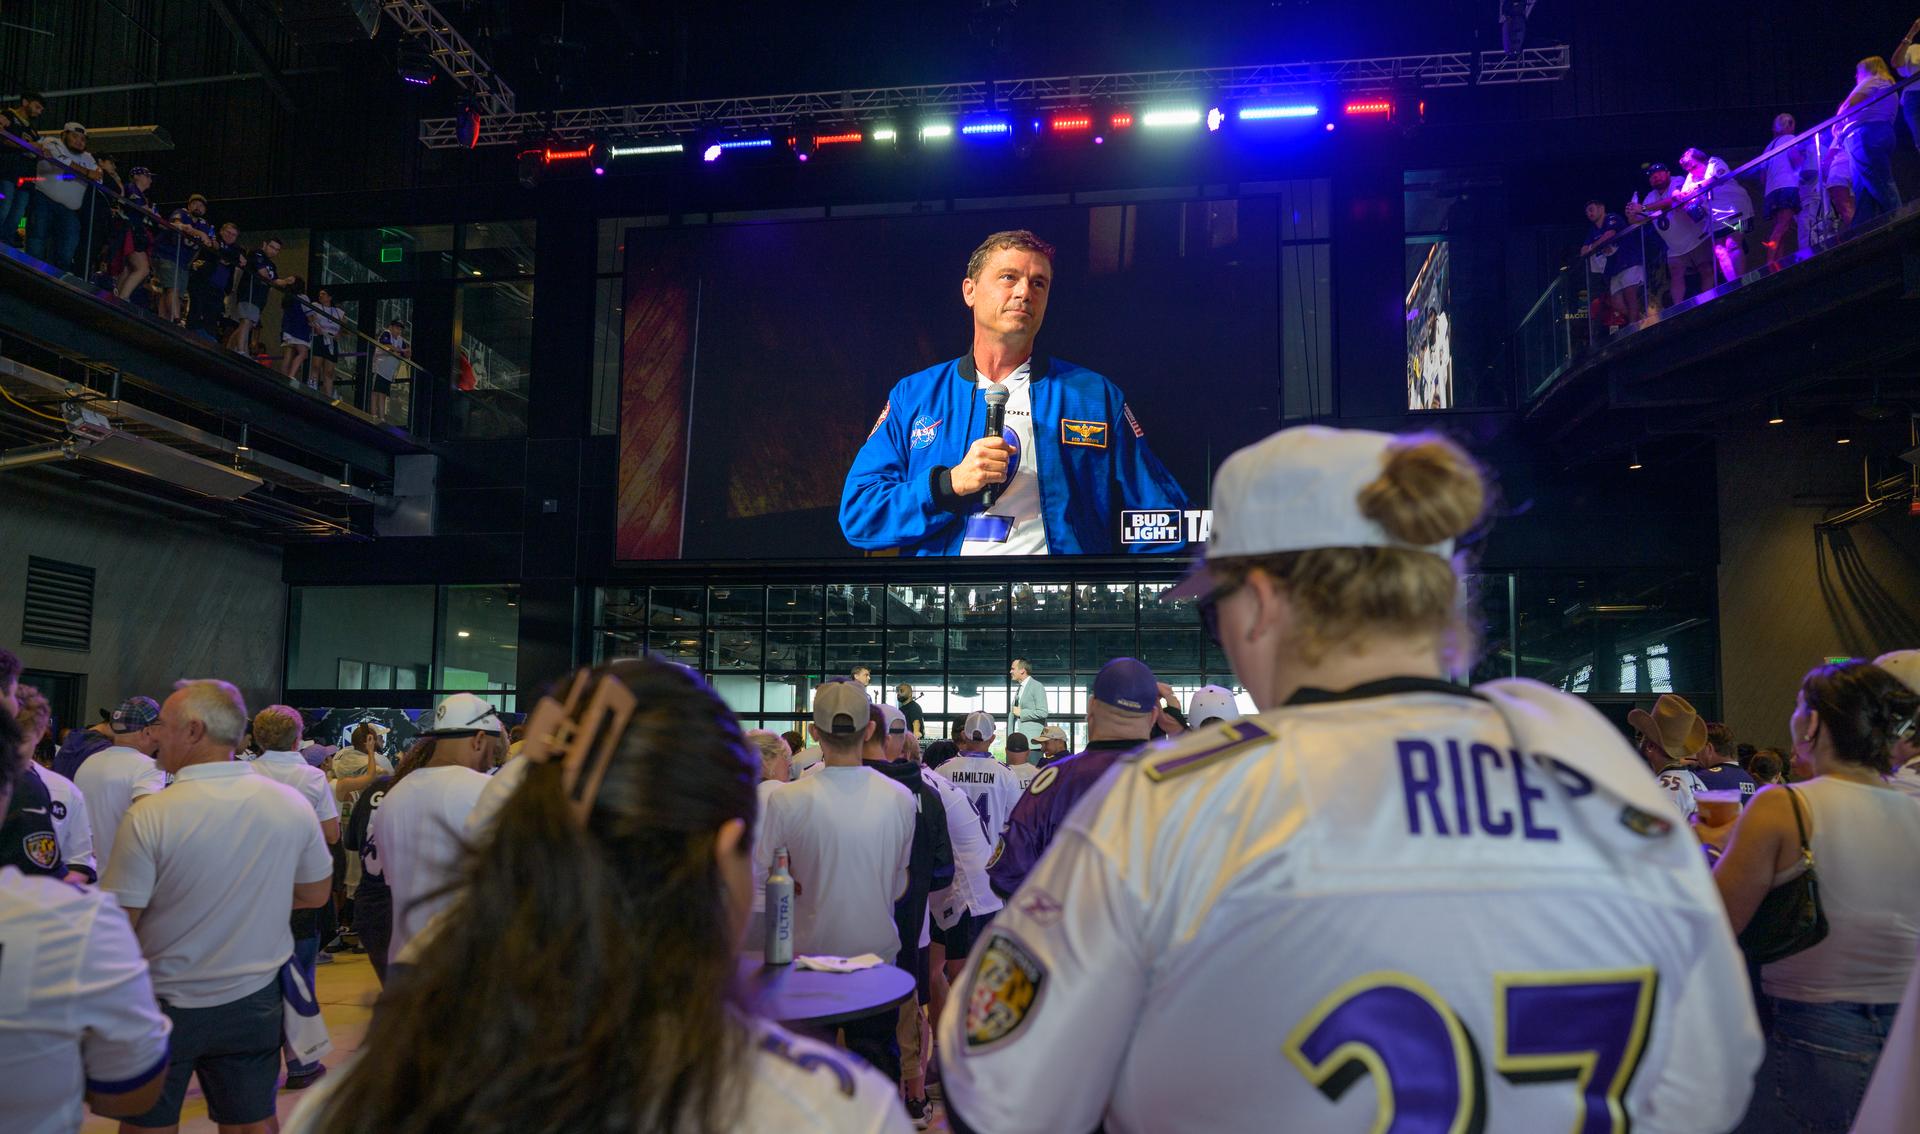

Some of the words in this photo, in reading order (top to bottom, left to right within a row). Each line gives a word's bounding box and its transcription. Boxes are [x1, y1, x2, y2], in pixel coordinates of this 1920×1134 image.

[1132, 513, 1170, 527] BUD
[1125, 526, 1178, 540] LIGHT
[952, 771, 995, 784] HAMILTON
[1396, 739, 1559, 841] RICE
[780, 894, 789, 940] ULTRA
